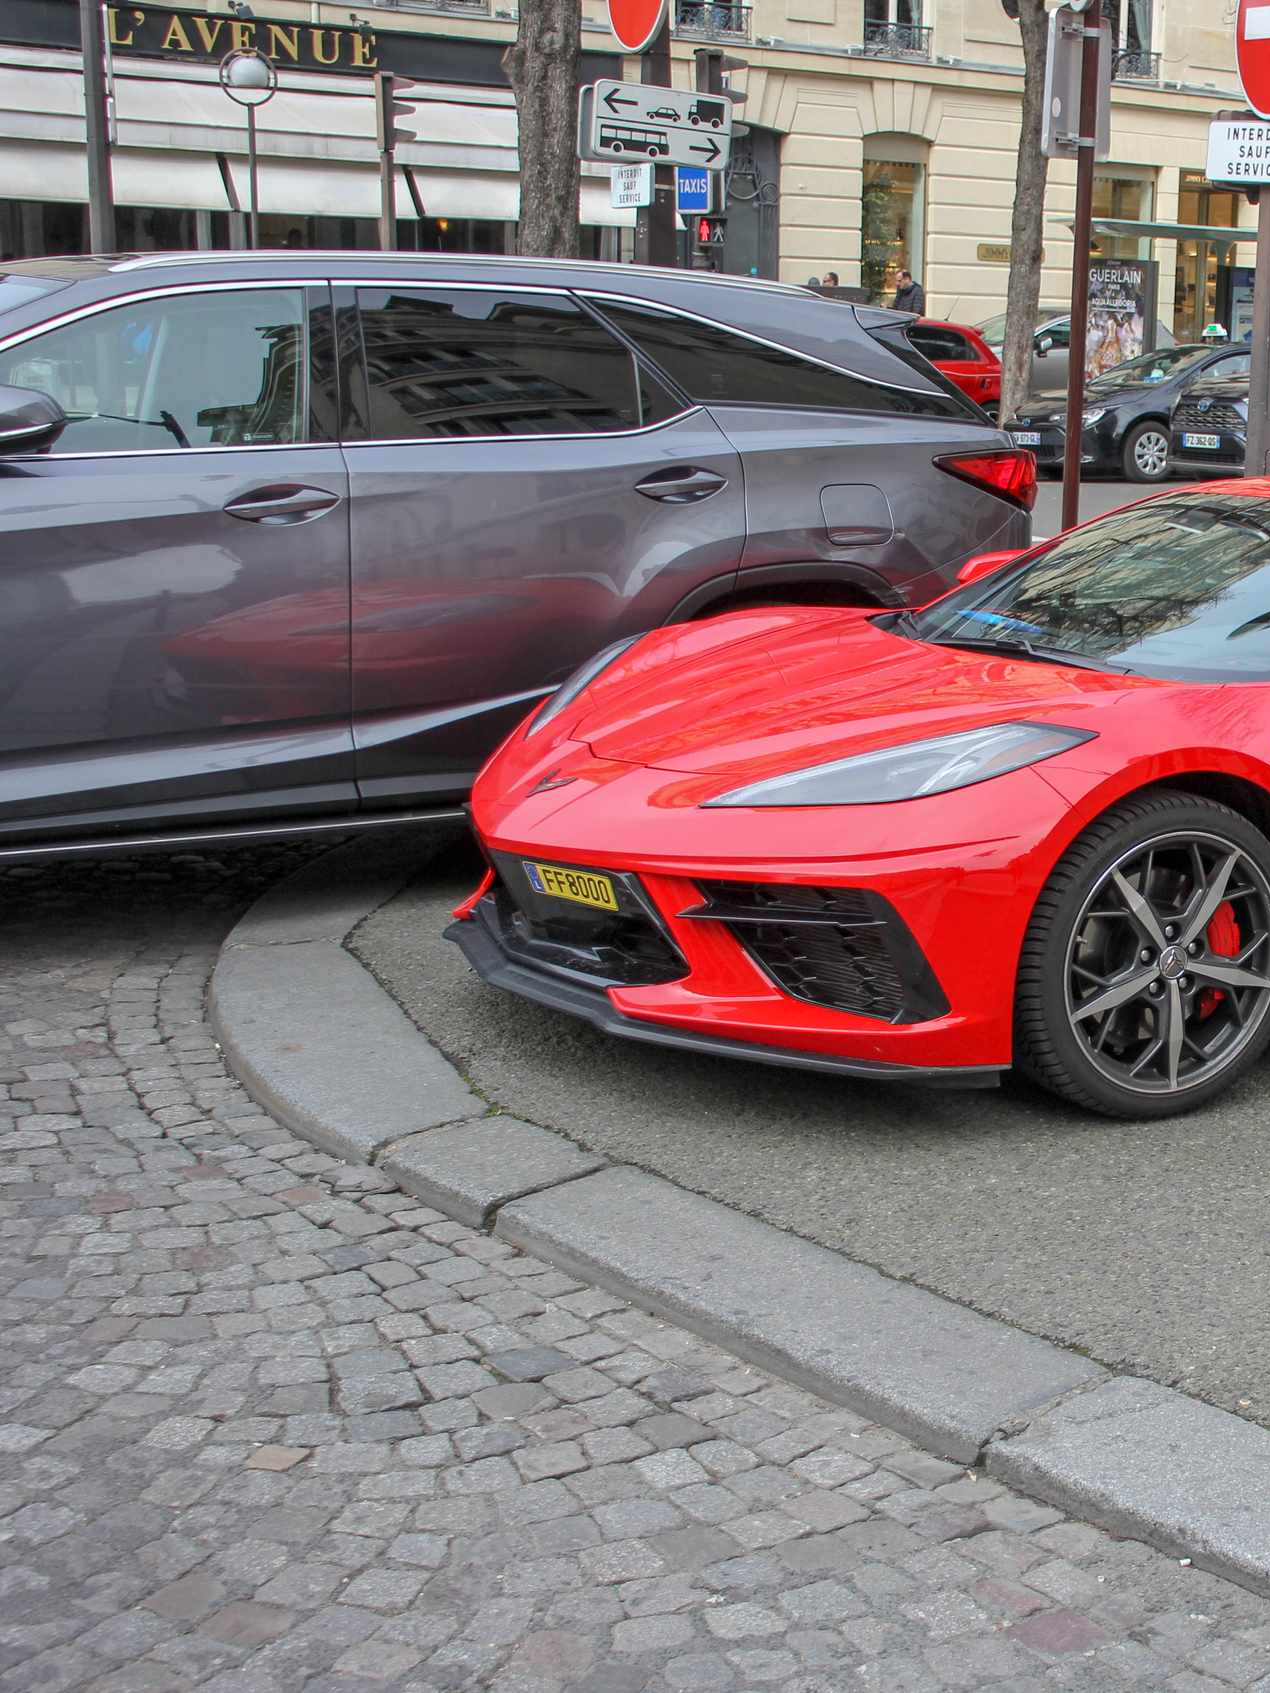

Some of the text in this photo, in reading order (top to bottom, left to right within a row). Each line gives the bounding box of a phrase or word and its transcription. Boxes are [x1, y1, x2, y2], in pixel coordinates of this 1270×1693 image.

[1239, 145, 1270, 159] SAUF
[617, 167, 643, 178] INTERDIT
[623, 181, 637, 193] SAUF
[679, 178, 707, 194] TAXIS
[619, 193, 641, 204] SERVICE
[982, 247, 1009, 259] JIMMY
[1089, 268, 1142, 284] GUERLAIN
[1091, 298, 1136, 308] AQUA ALLEGORIA
[542, 868, 611, 904] FF8000
